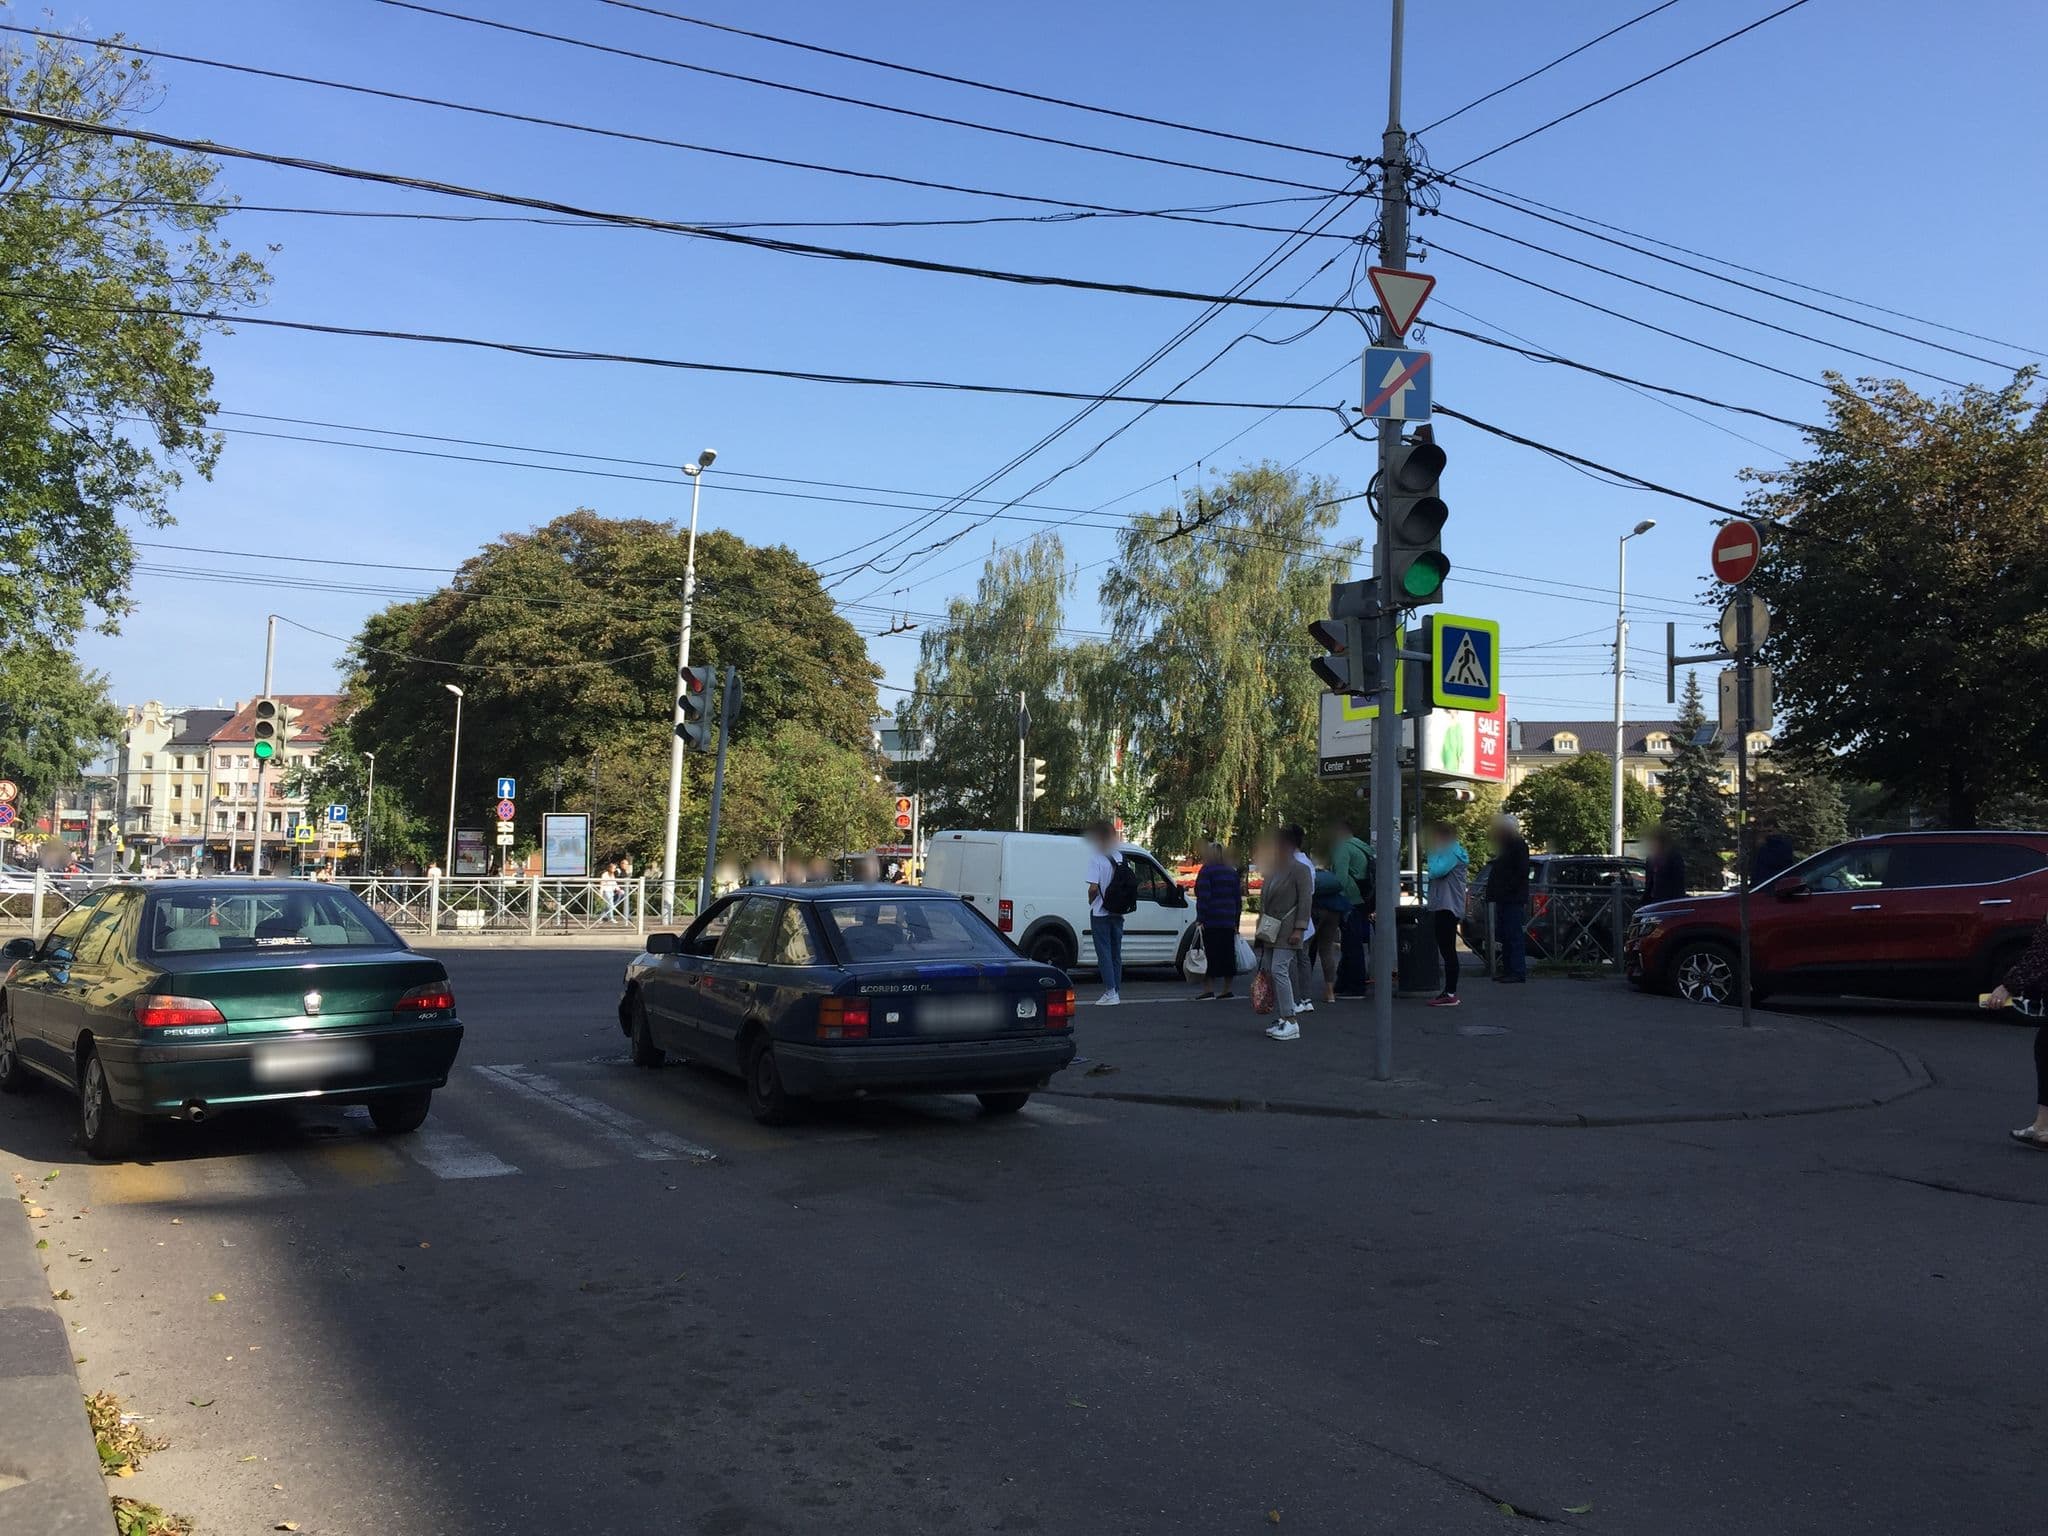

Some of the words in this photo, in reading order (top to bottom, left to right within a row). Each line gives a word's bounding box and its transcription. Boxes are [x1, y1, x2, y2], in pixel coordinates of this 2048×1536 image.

[1478, 717, 1500, 736] SALE
[1323, 762, 1345, 772] Center
[333, 806, 345, 820] P
[860, 985, 899, 993] SCORPIO
[163, 1026, 217, 1037] PEUGEOT
